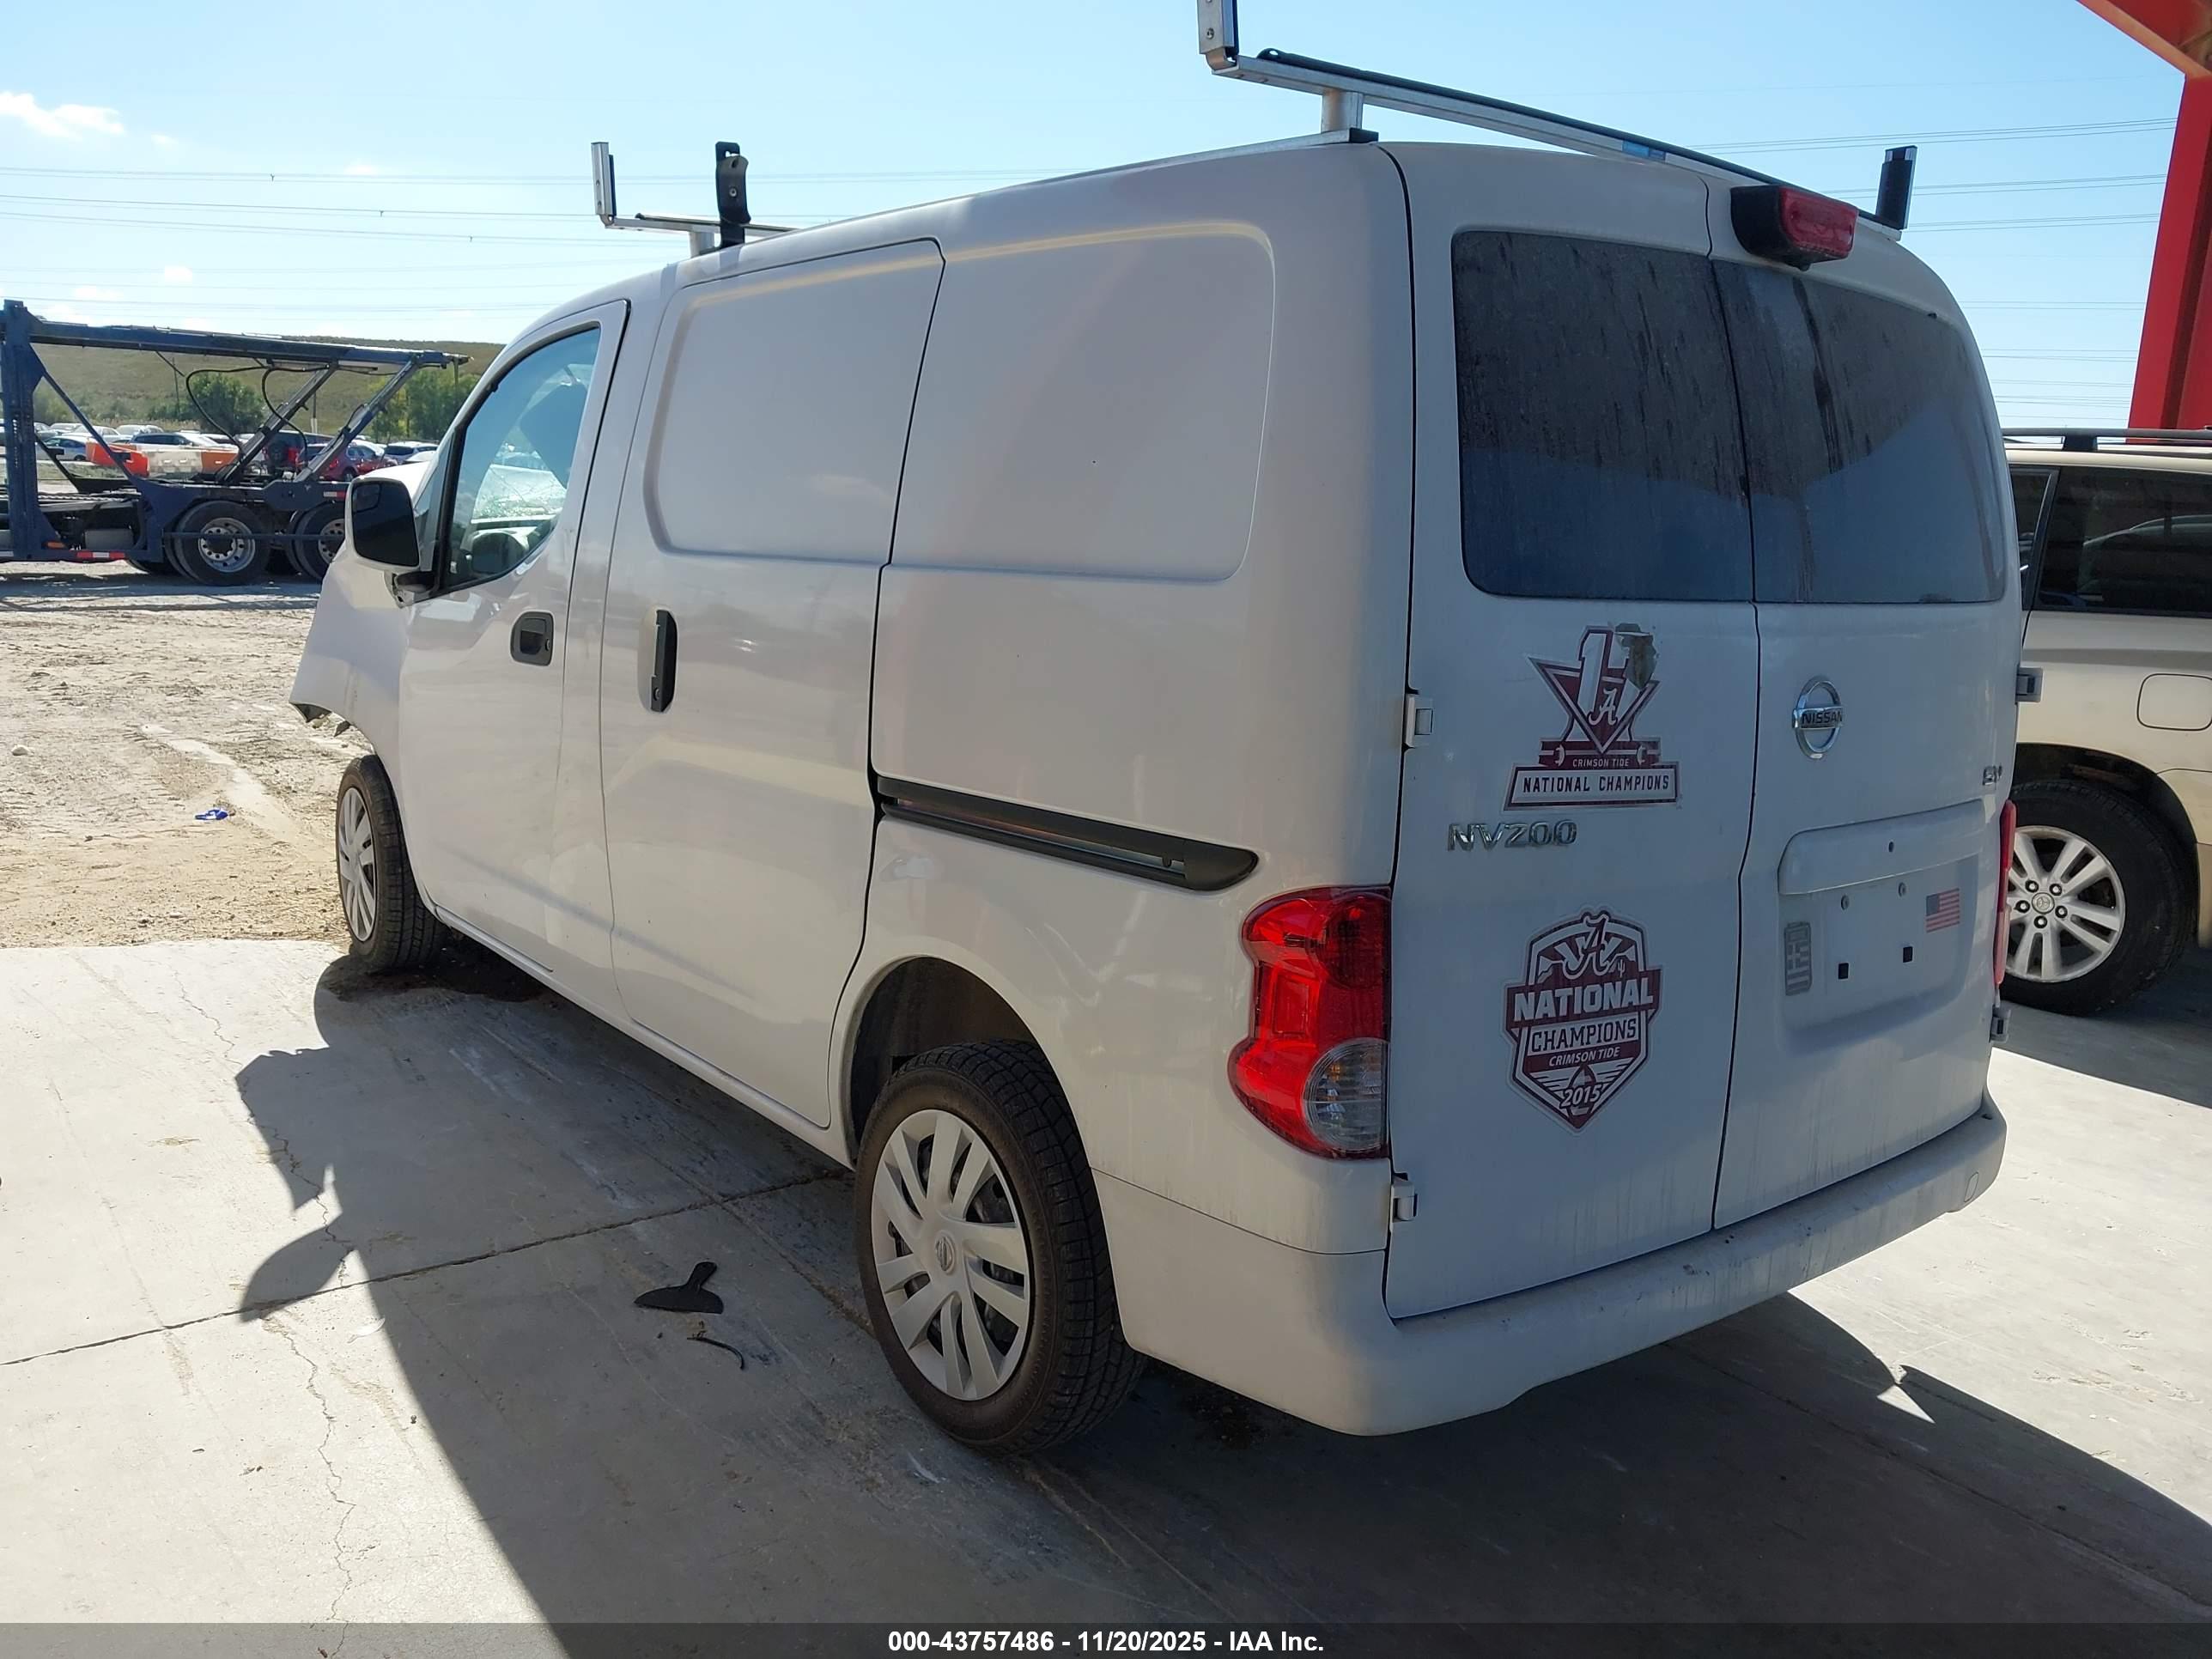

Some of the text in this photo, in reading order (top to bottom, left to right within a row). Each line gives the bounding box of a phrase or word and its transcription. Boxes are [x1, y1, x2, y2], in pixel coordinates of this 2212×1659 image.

[1802, 711, 1843, 724] NISSAN
[1572, 757, 1630, 768] CRIMSON TIDE
[1522, 775, 1670, 793] NATIONAL CHAMPIONS
[1448, 820, 1577, 852] NV200
[1513, 976, 1654, 1022] NATIONAL
[1531, 1018, 1638, 1053] CHAMPIONS
[1548, 1046, 1621, 1067] CRIMSON TIDE
[1561, 1085, 1601, 1108] 2015
